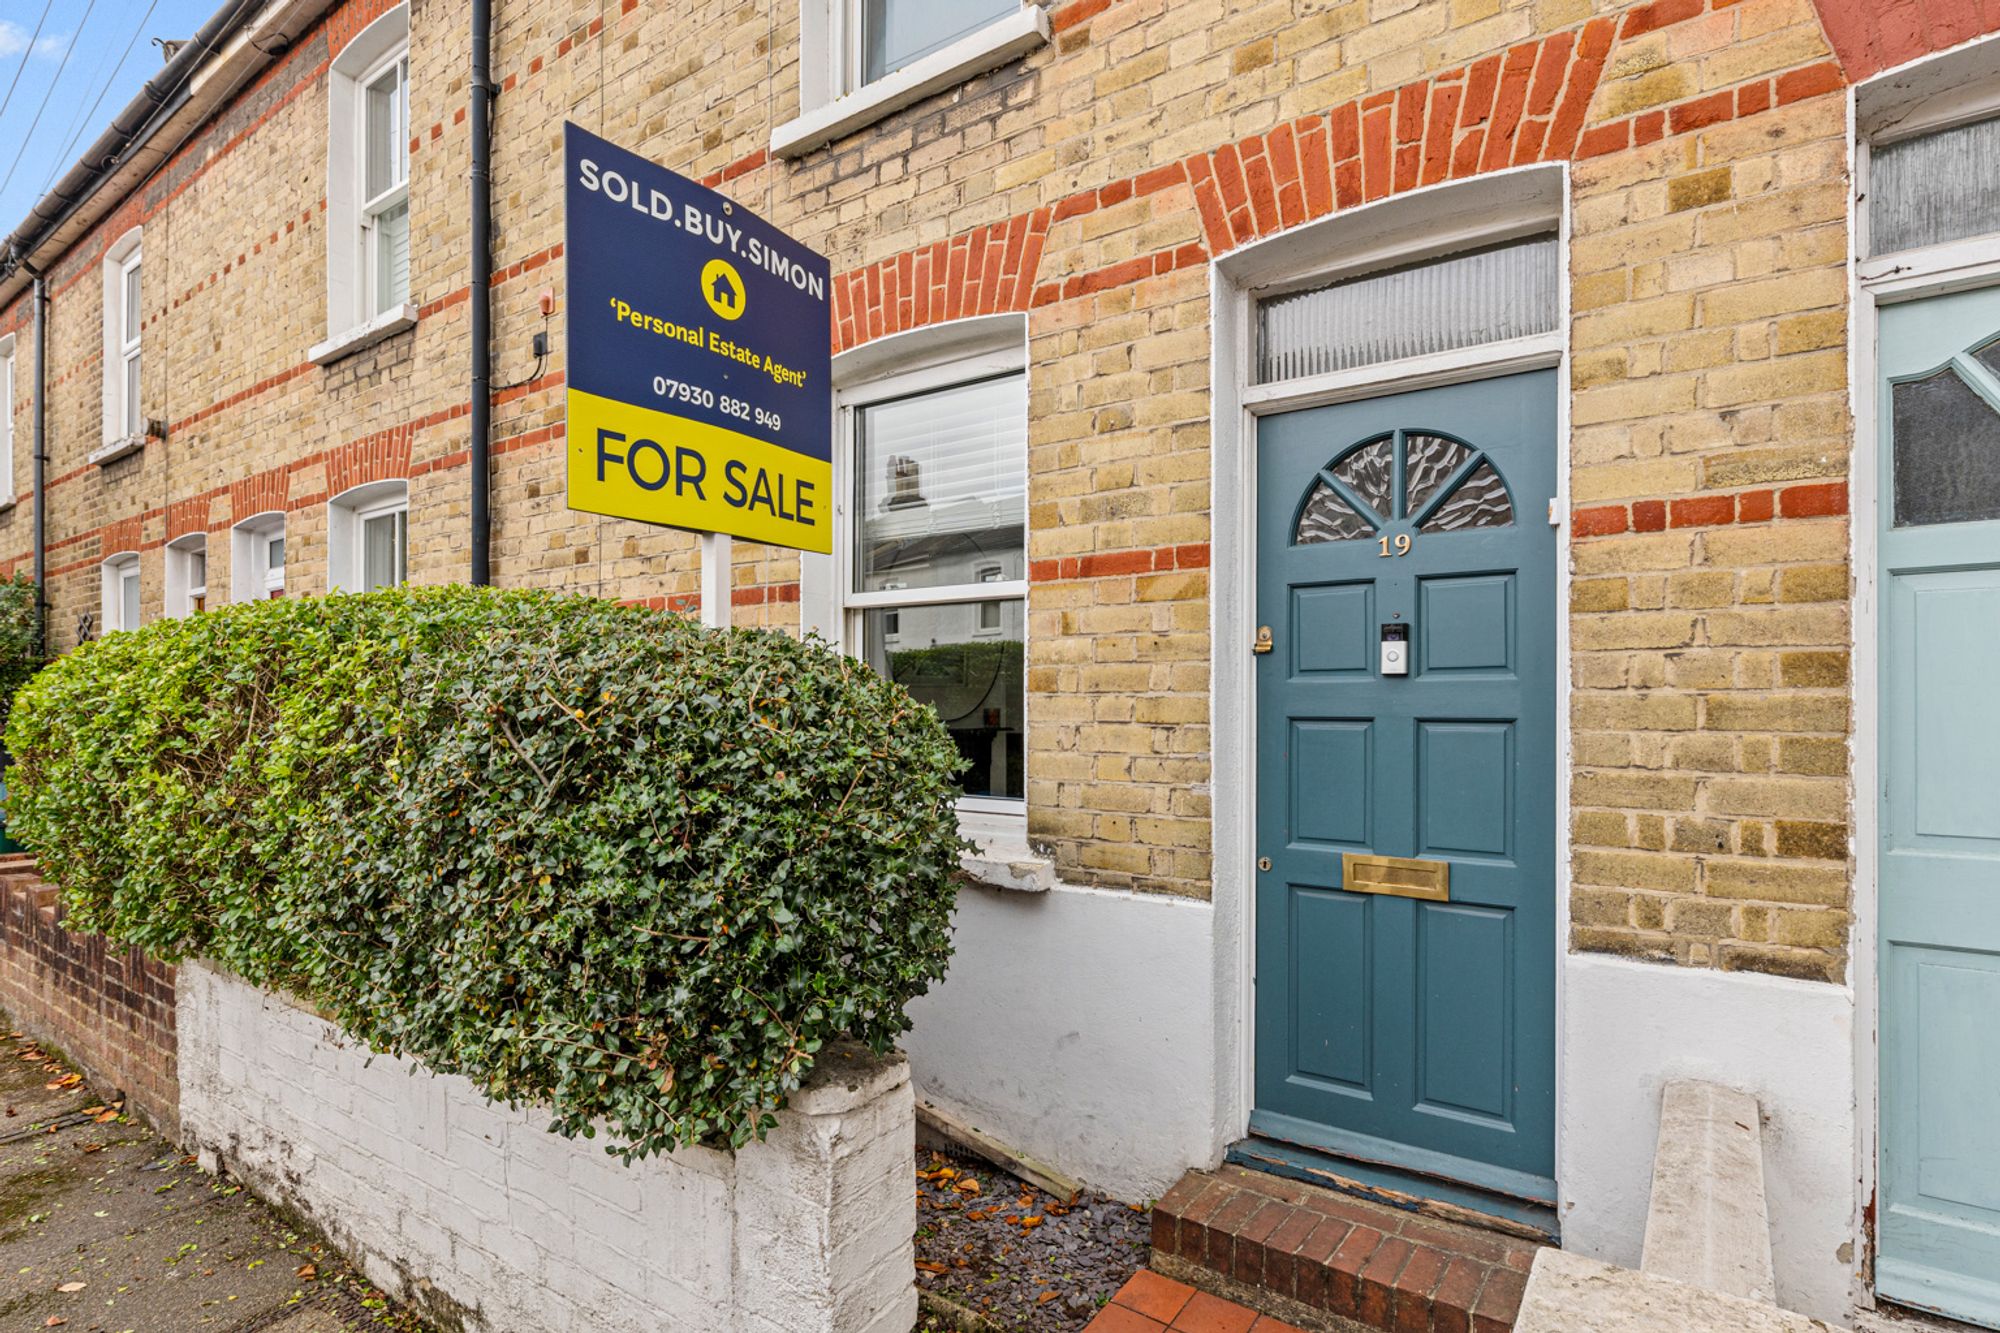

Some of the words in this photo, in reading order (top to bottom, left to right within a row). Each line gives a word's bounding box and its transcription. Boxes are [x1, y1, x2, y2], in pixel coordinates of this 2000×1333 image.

[579, 158, 825, 301] SOLD.BUY.SIMON
[708, 331, 761, 369] Estate
[653, 375, 714, 409] 07930
[719, 394, 751, 422] 882
[754, 408, 782, 431] 949
[596, 427, 708, 502] FOR
[723, 460, 816, 527] SALE
[1378, 533, 1412, 558] 19
